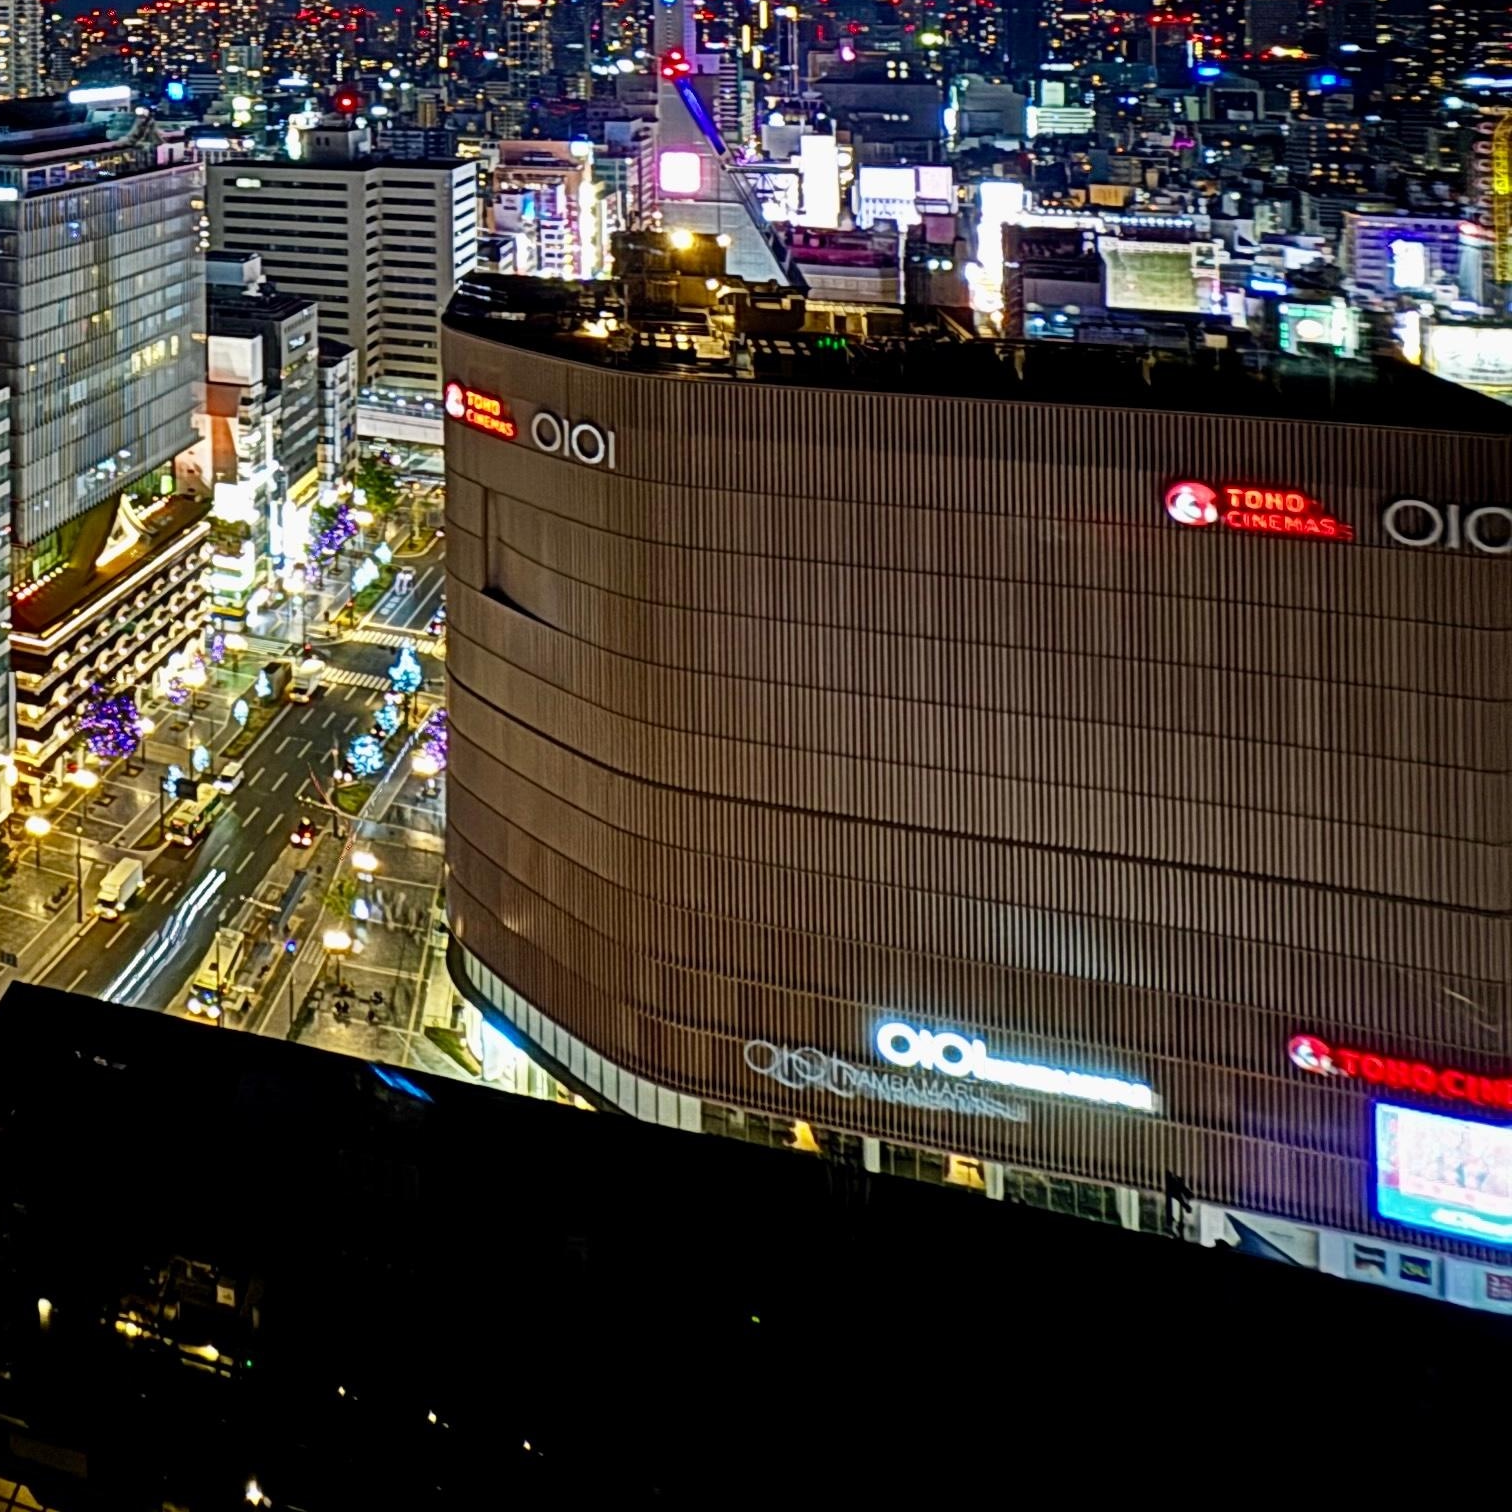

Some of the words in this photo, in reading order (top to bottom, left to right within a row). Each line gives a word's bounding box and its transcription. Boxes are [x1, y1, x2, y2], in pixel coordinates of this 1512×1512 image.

[466, 391, 501, 416] TOHO
[466, 409, 515, 438] CINEMAS
[1226, 488, 1305, 513] TOHO
[1226, 510, 1337, 536] CINEMAS
[1336, 1049, 1438, 1095] TOHO
